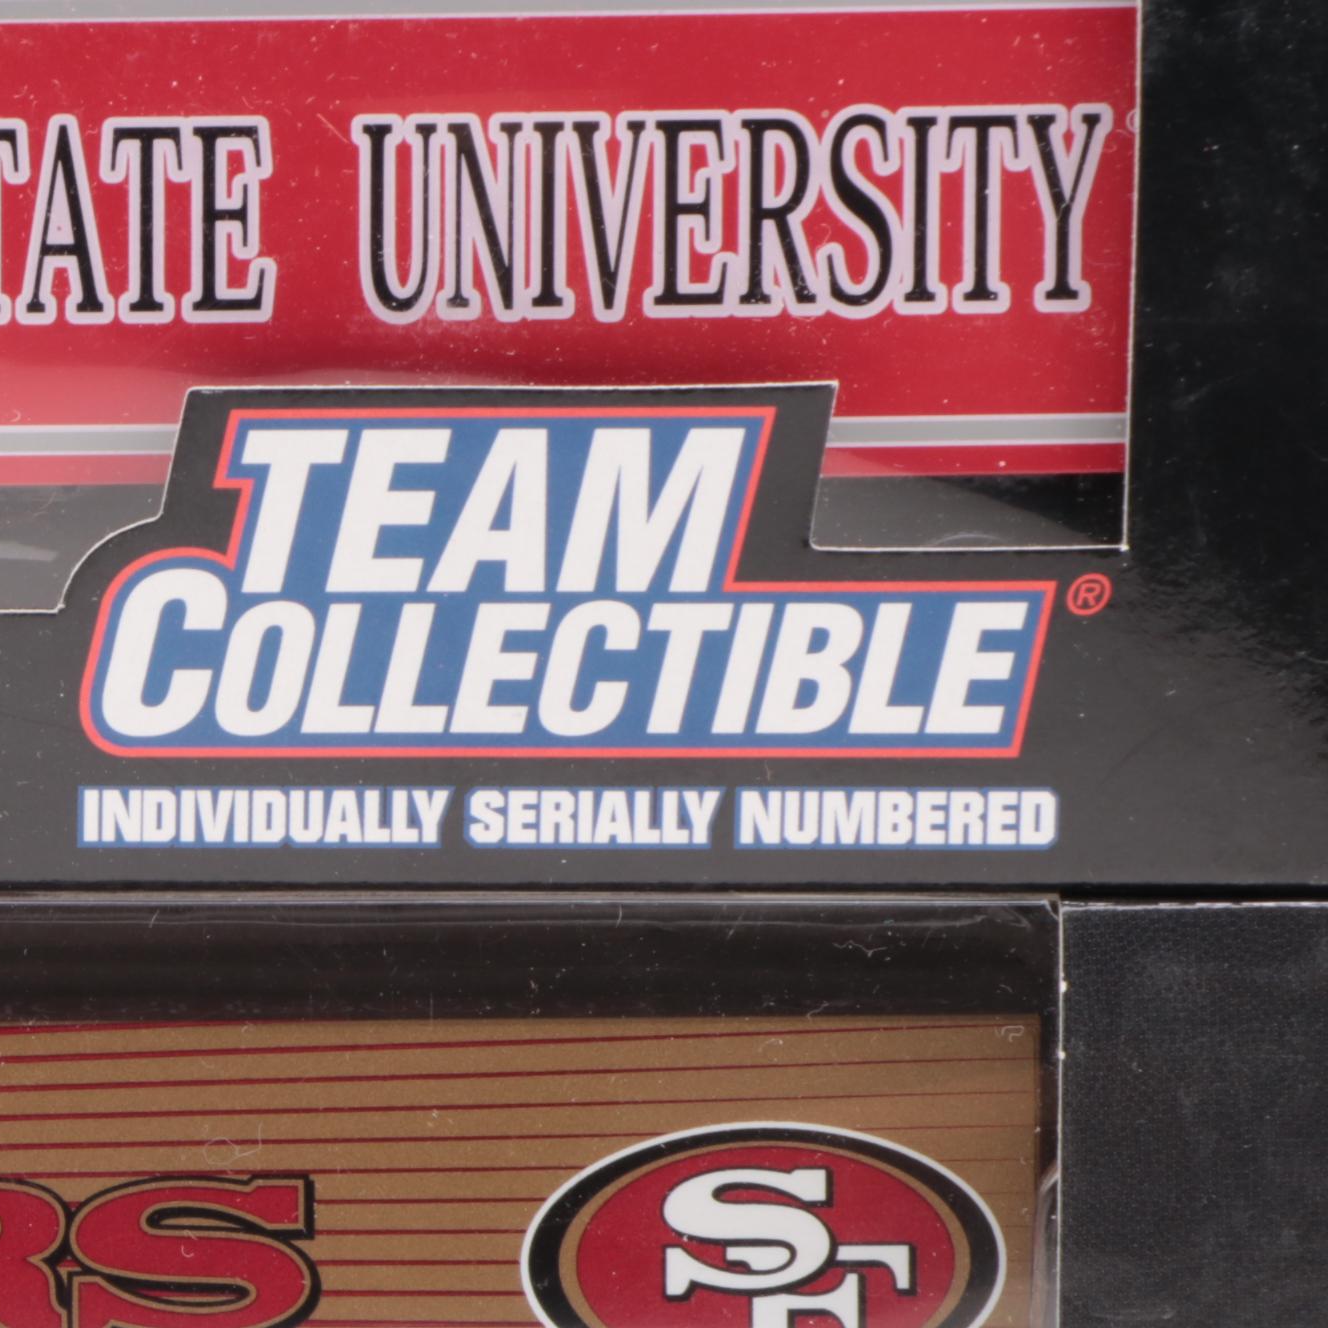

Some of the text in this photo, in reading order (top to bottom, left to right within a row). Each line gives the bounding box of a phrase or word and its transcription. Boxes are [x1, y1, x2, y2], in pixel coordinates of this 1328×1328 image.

[351, 102, 1113, 324] UNIVERSITY
[239, 427, 746, 594] TEAM
[100, 567, 1029, 737] COLLECTIBLE
[81, 788, 1059, 847] INDIVIDUALLY SERIALLY NUMBERED
